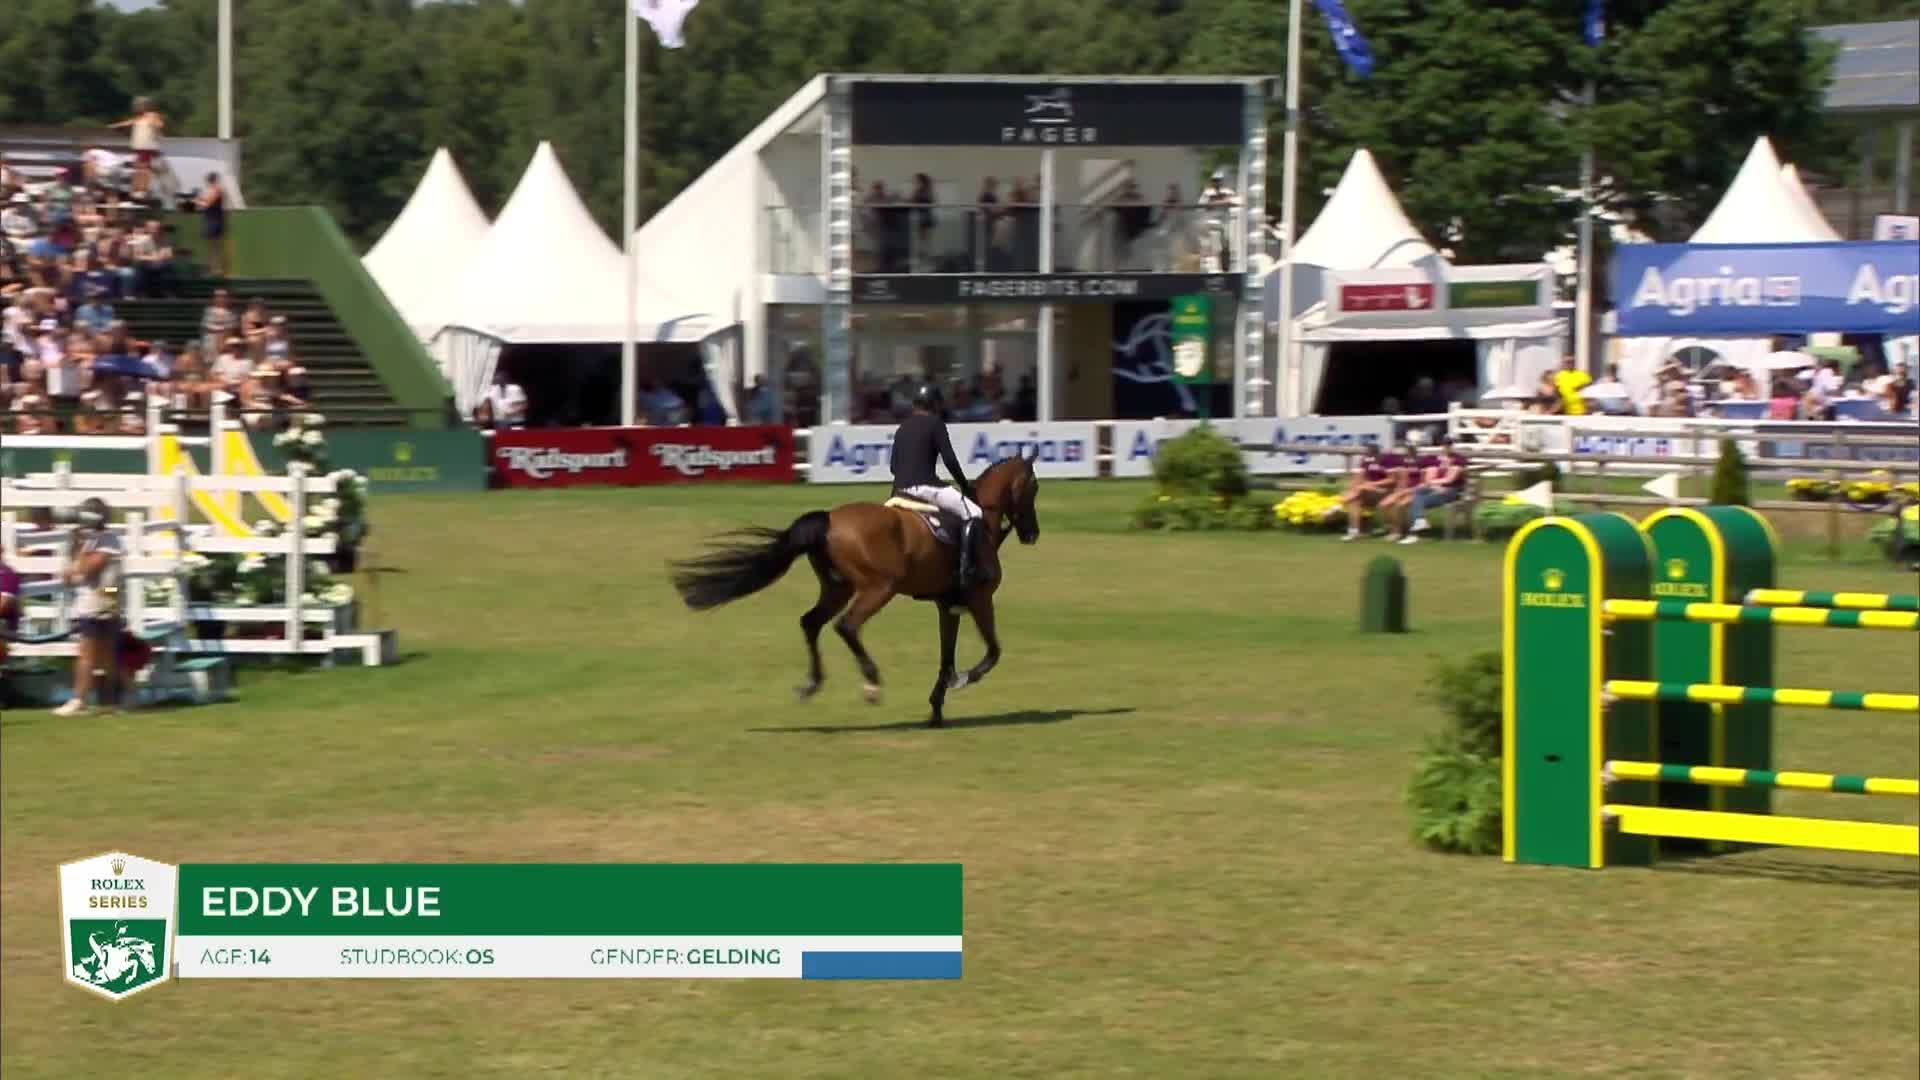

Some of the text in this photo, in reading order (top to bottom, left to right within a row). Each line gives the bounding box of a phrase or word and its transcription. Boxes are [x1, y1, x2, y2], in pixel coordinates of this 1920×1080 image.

[1001, 127, 1098, 142] FAGER
[957, 280, 1138, 296] FAGERBITS.COM
[1631, 266, 1762, 316] Agria
[1845, 263, 1919, 313] Ag
[825, 434, 894, 474] Agri
